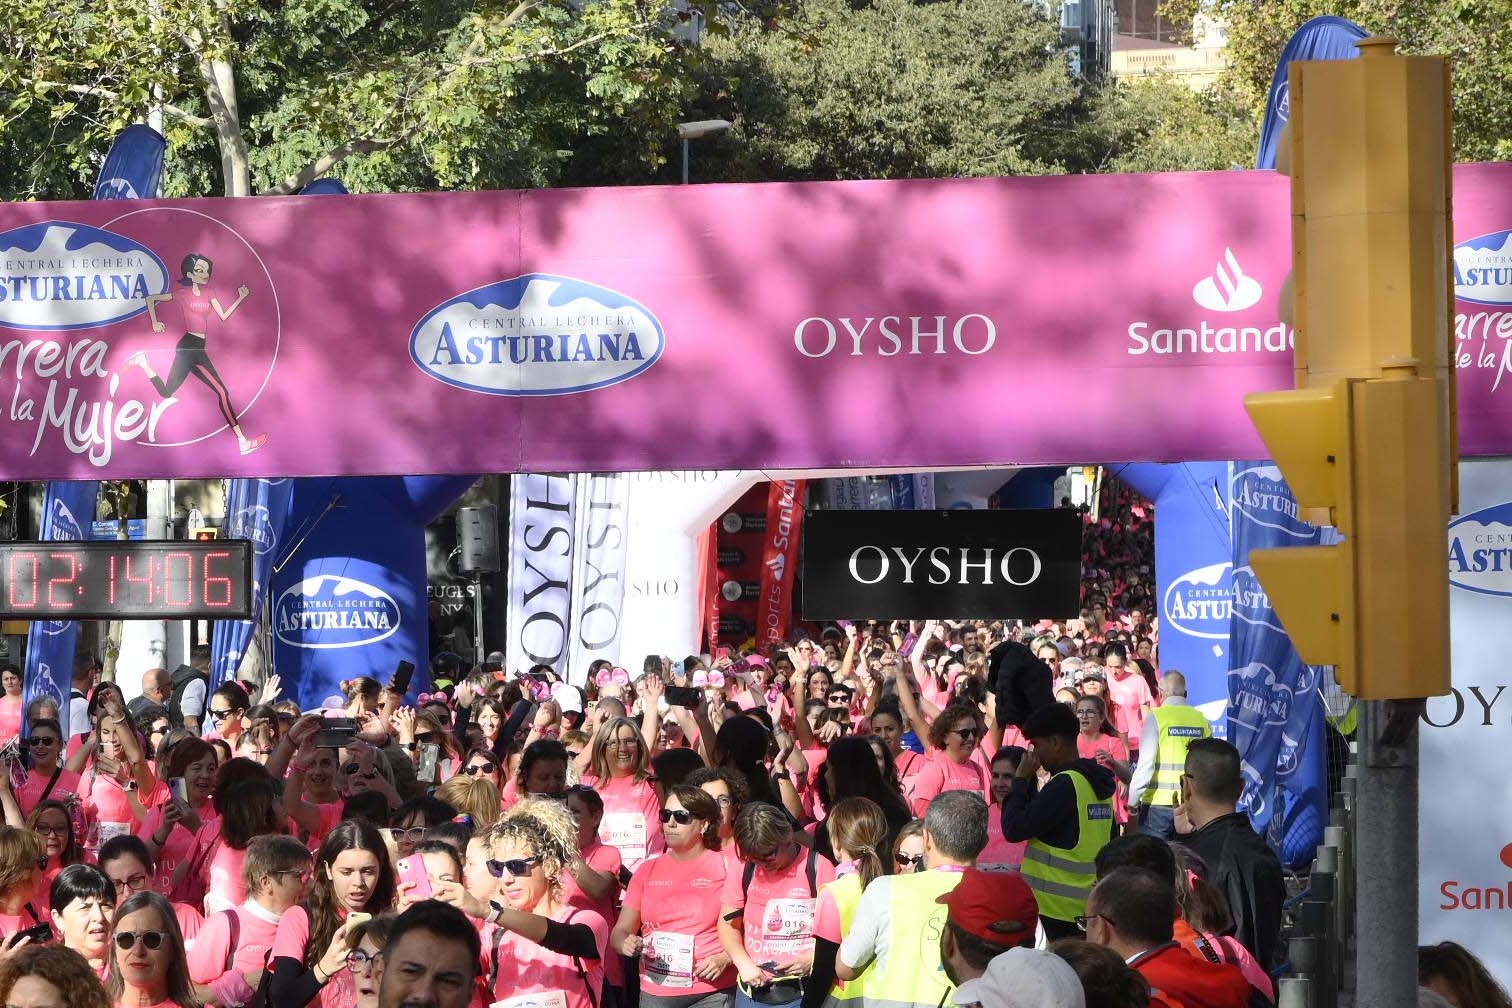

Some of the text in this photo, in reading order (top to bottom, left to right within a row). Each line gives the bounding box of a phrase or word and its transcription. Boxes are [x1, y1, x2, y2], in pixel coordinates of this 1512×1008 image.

[71, 256, 144, 270] LECHERA
[469, 315, 636, 330] CENTRAL LECHERA
[794, 313, 997, 358] OYSHO
[1127, 321, 1294, 354] Santand
[429, 321, 645, 366] ASTURIANA
[1478, 340, 1496, 368] la
[10, 379, 35, 421] la
[29, 373, 180, 467] Mujer
[848, 545, 1042, 585] OYSHO
[278, 605, 392, 633] ASTURIANA
[291, 599, 387, 609] CENTRAL LECHERA
